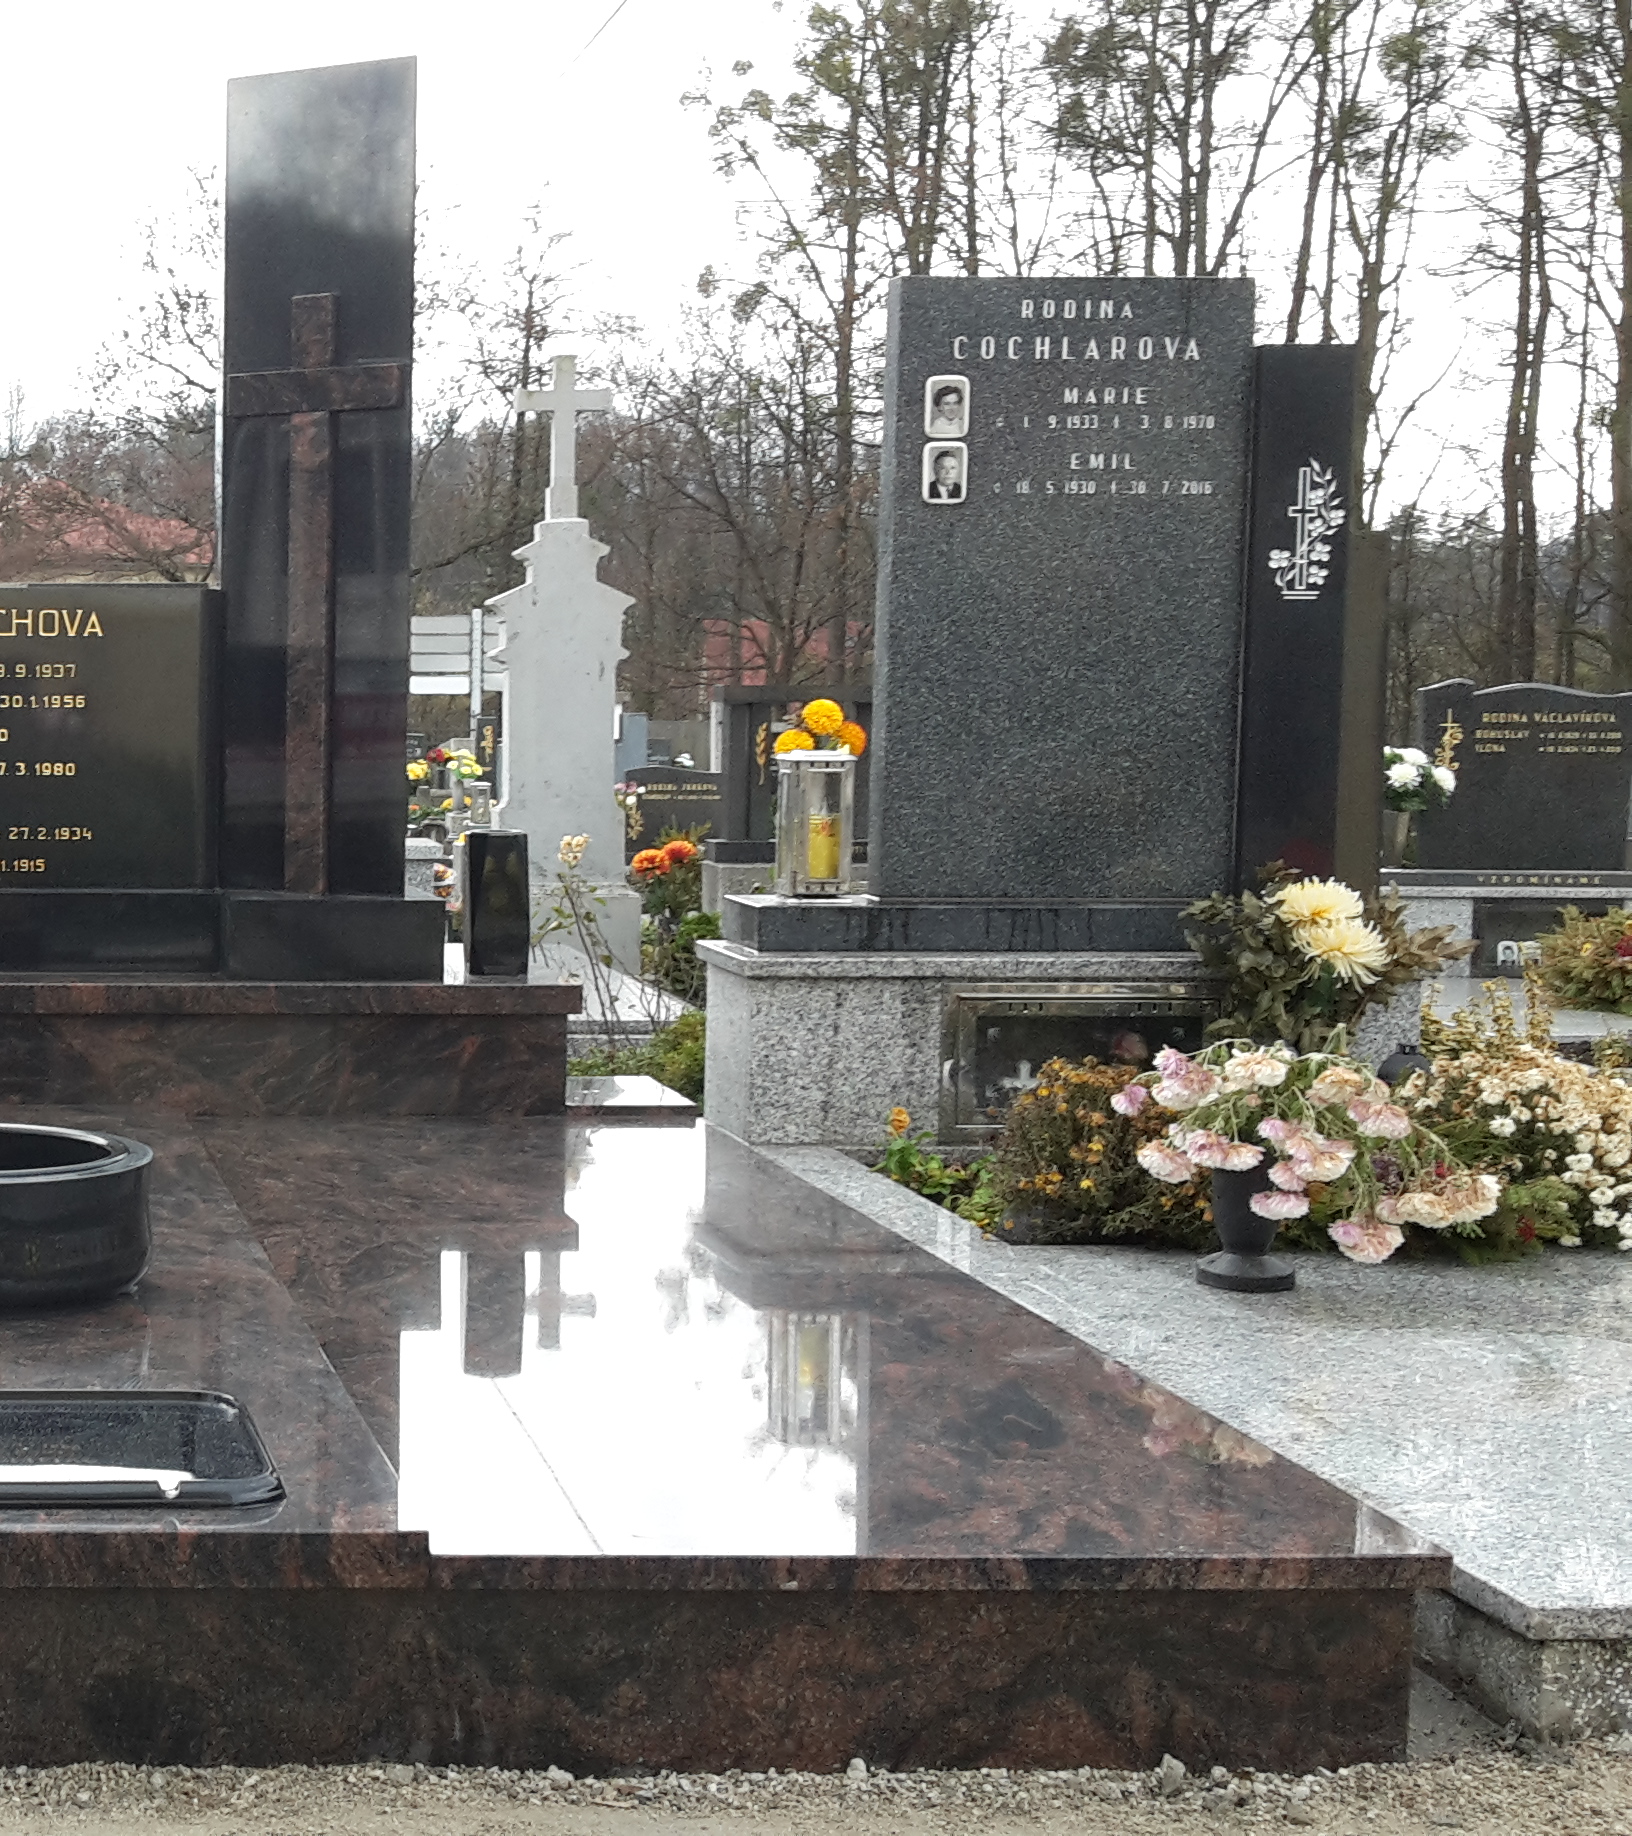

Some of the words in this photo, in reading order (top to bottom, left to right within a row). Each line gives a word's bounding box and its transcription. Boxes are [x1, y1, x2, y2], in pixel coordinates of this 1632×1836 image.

[1021, 300, 1134, 319] RODINA
[953, 336, 1201, 361] COCHLAROVA
[1063, 387, 1149, 405] MARIE
[1070, 453, 1137, 470] EMIL
